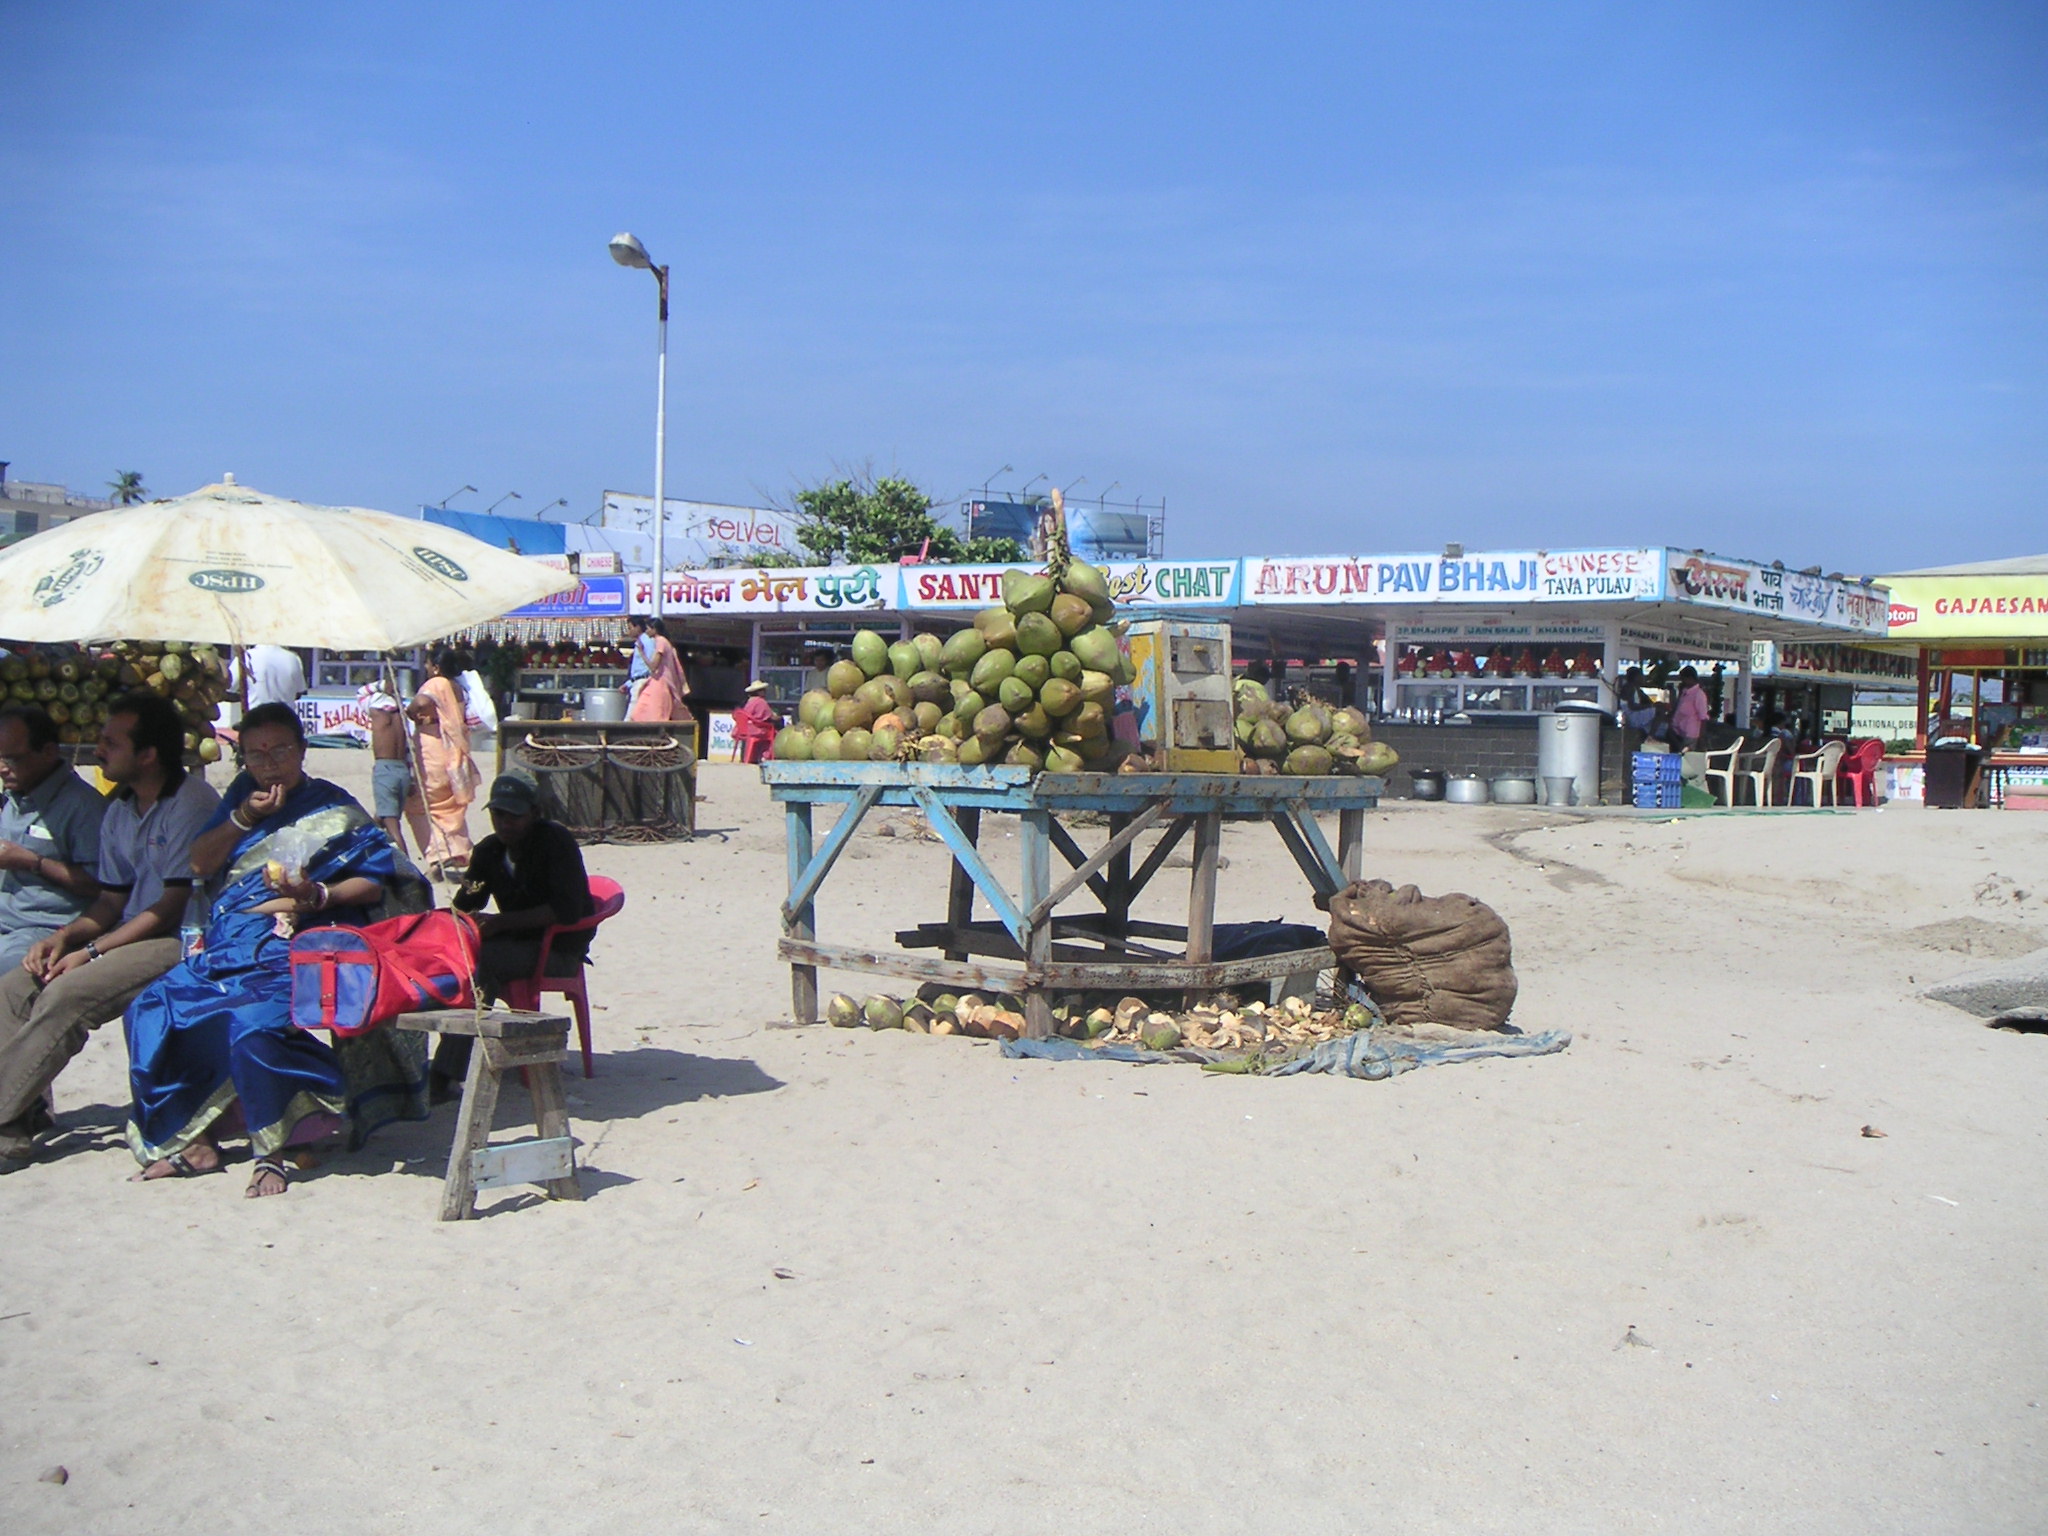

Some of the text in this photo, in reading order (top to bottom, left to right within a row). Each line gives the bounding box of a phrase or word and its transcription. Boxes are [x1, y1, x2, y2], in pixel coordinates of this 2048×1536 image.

[587, 556, 612, 568] CHINESE
[1544, 553, 1639, 575] CHINESE
[195, 573, 257, 589] HPSC
[741, 570, 808, 603] भेल
[814, 565, 882, 609] पुरी
[1155, 567, 1230, 598] CHAT
[1254, 560, 1538, 595] ARUN PAV BHAJI
[1544, 577, 1583, 595] TAVA
[1761, 569, 1783, 588] पाव
[1753, 589, 1784, 611] भाजी
